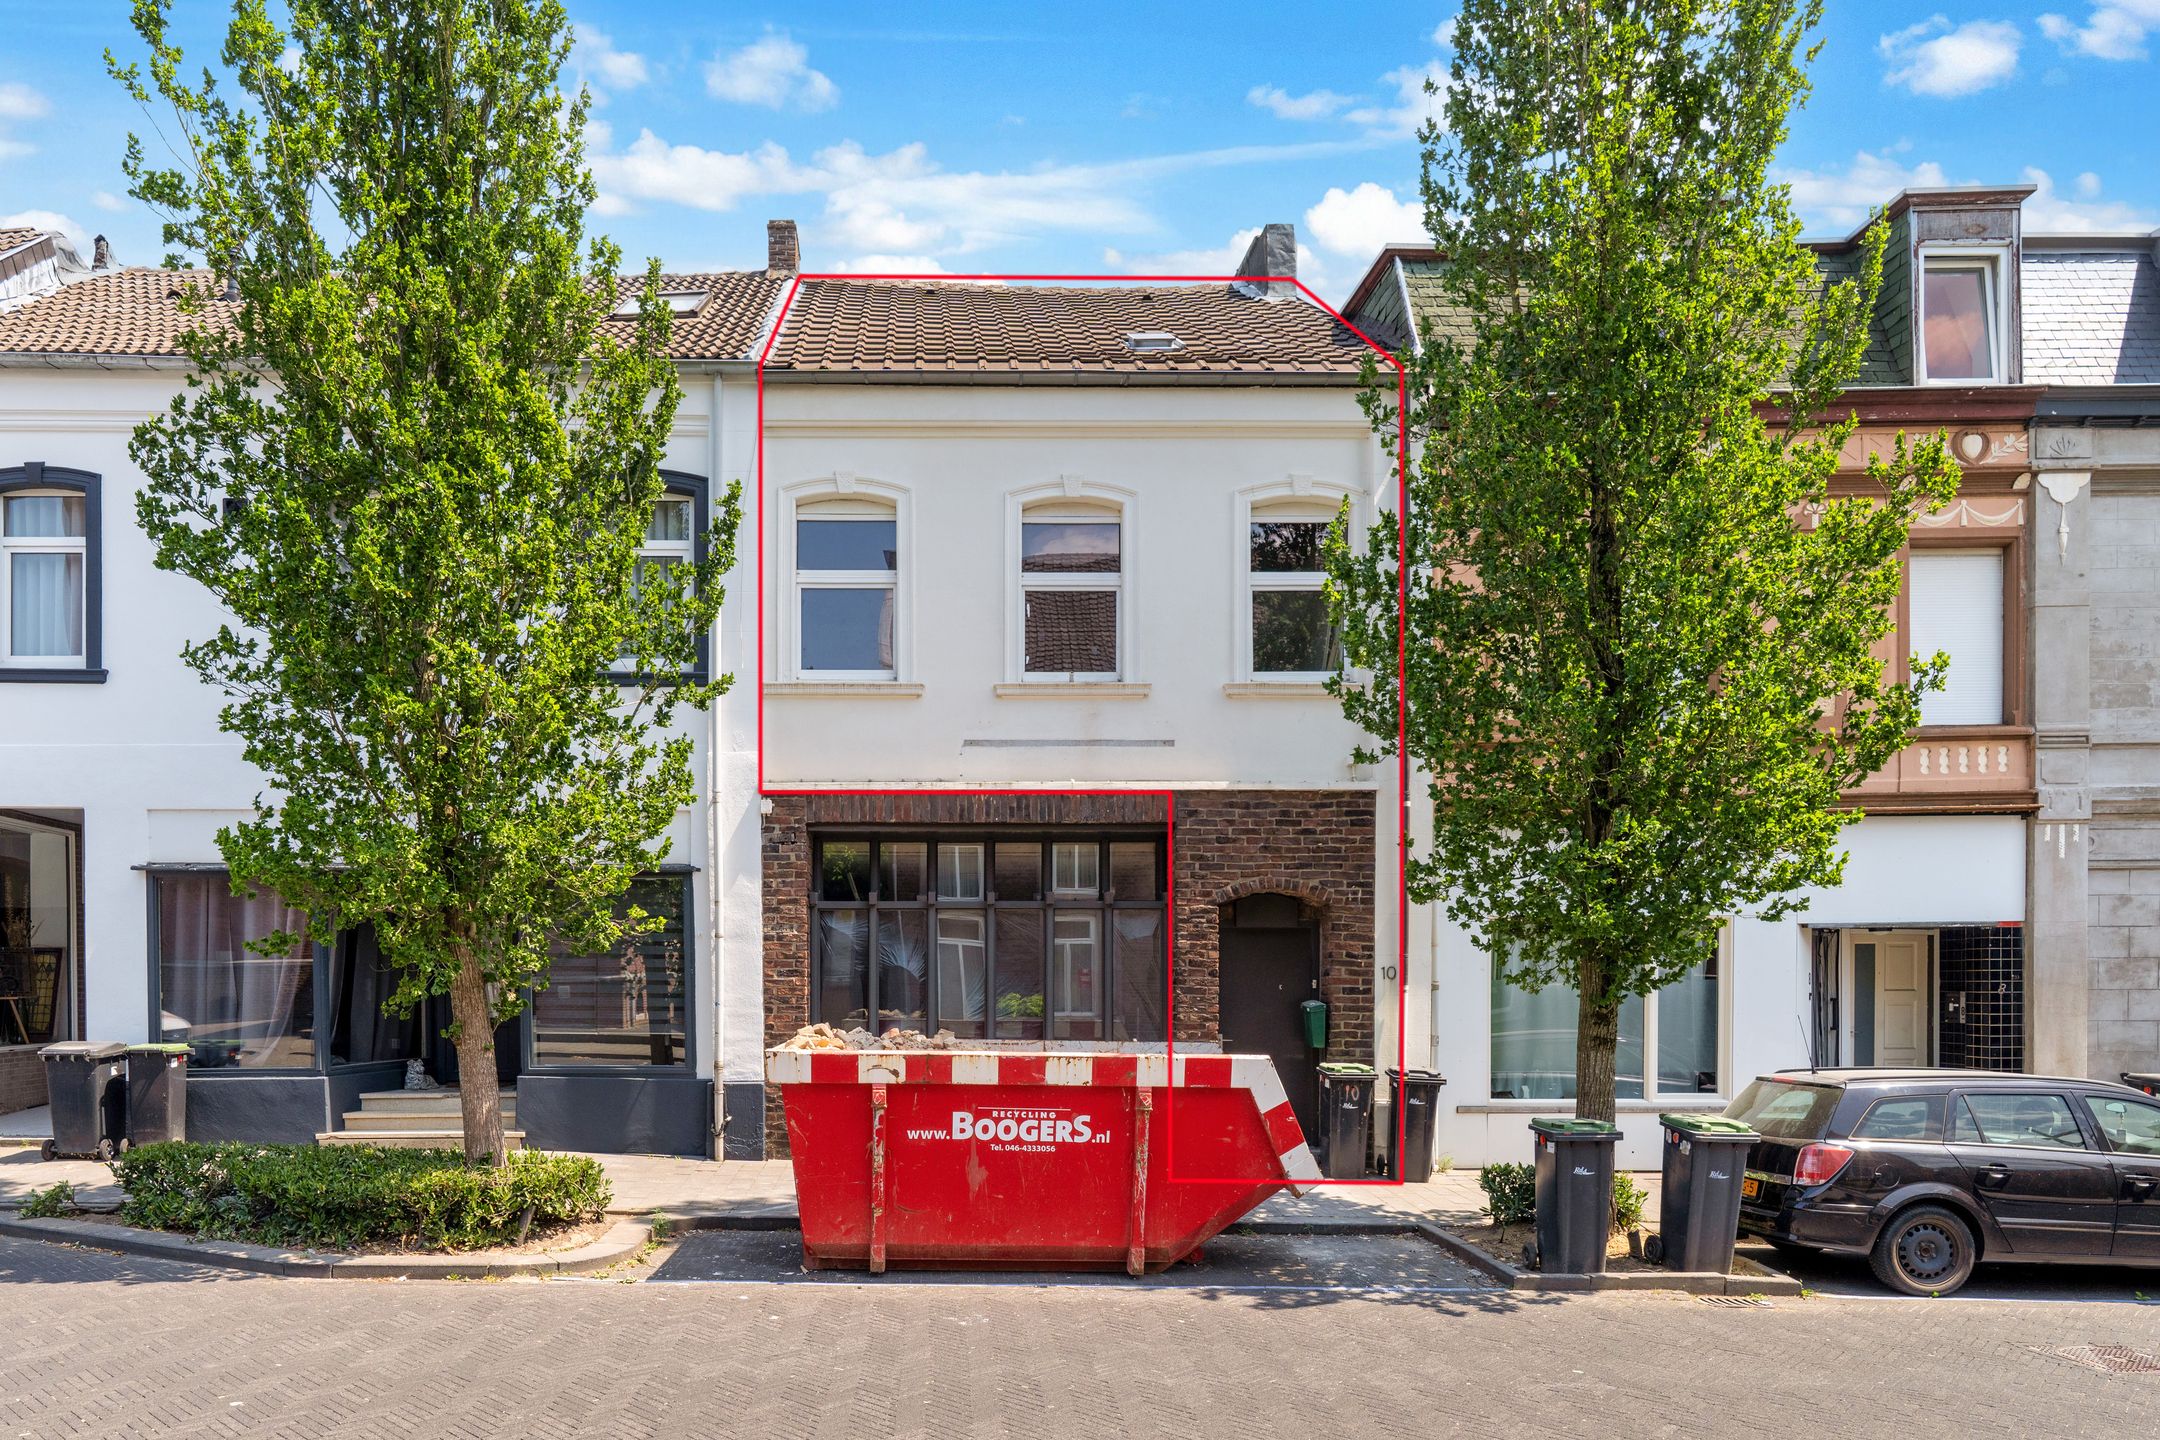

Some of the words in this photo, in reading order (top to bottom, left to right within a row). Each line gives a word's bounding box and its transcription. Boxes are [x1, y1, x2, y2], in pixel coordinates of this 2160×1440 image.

[1381, 966, 1397, 980] 10
[1345, 1084, 1360, 1101] 10
[992, 1110, 1057, 1119] RECYCLING
[1005, 1144, 1056, 1152] 046-4333056
